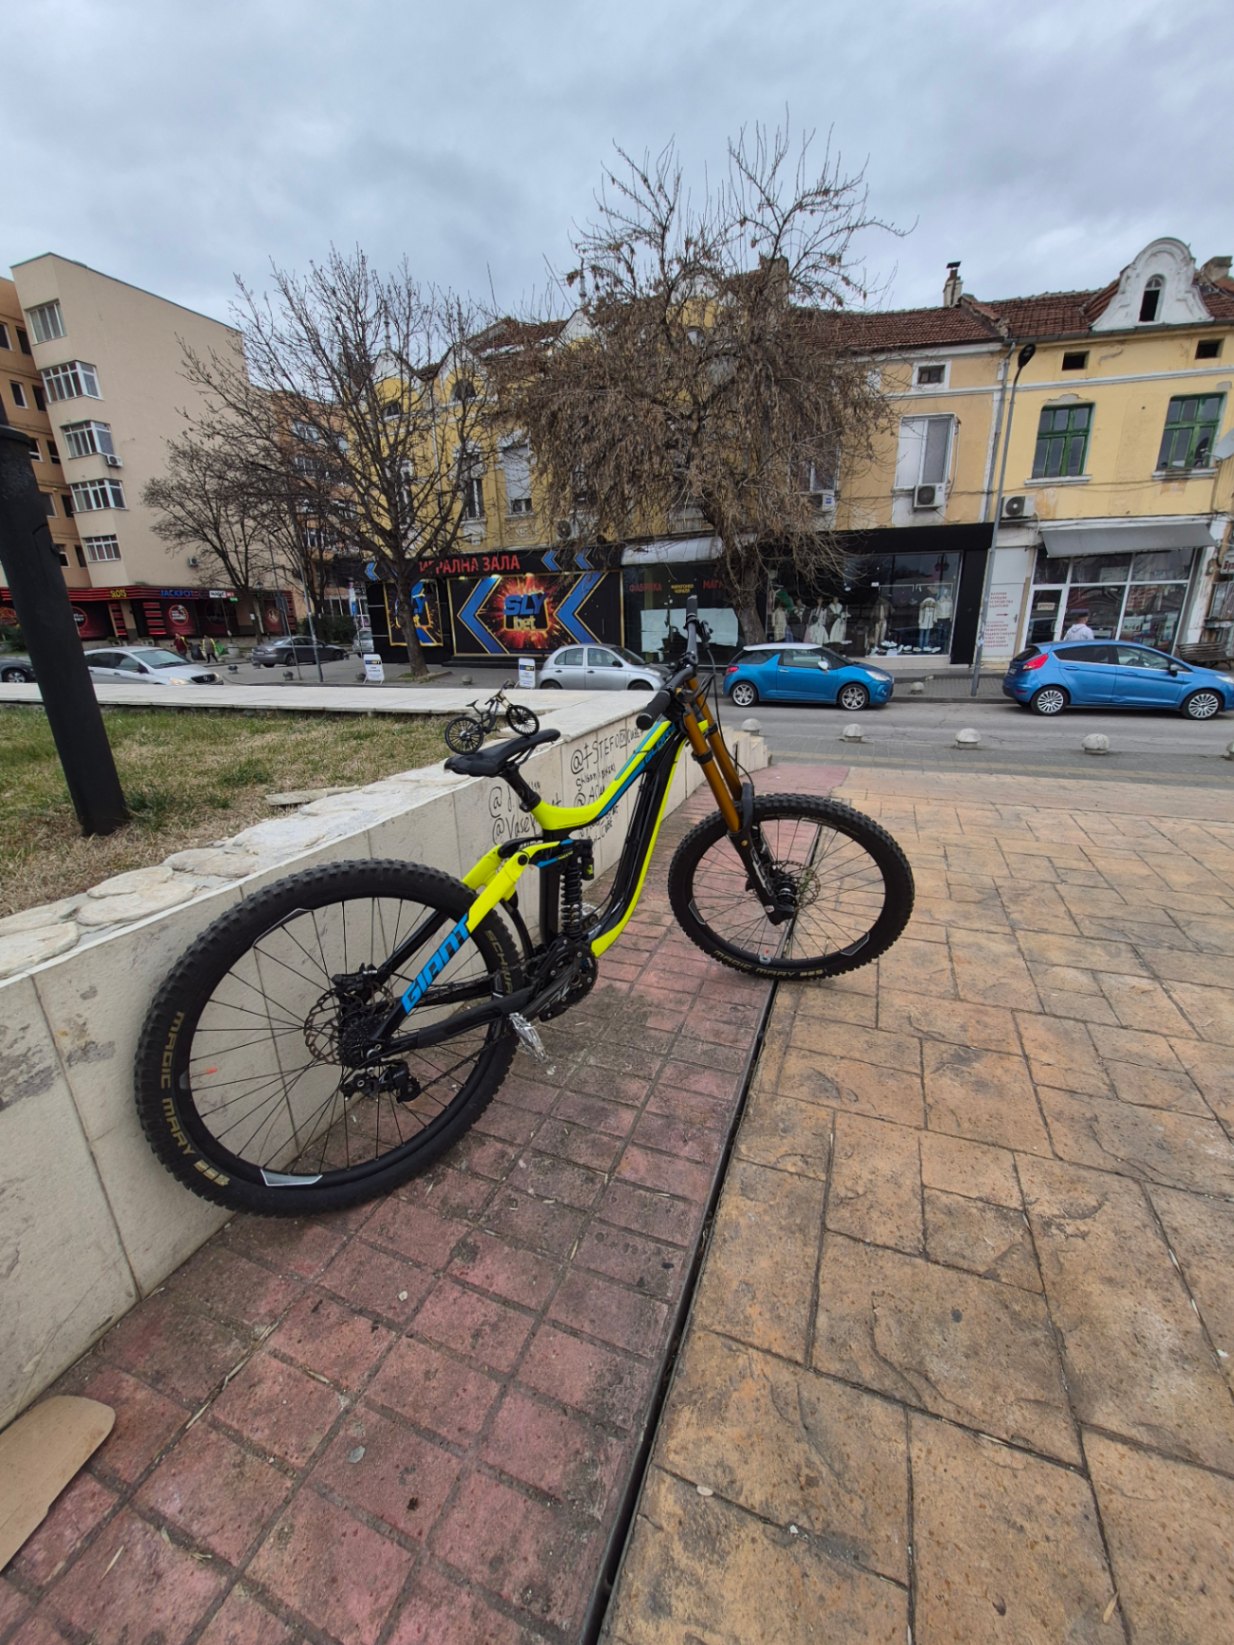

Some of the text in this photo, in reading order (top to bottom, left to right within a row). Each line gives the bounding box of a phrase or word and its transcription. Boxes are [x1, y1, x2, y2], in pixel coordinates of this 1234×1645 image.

[482, 554, 520, 571] ЗАЛА
[504, 593, 546, 615] SLY
[513, 616, 536, 630] bet
[401, 913, 470, 1015] GIANT
[755, 967, 796, 977] MARY
[160, 1010, 197, 1156] MAGIC MARY
